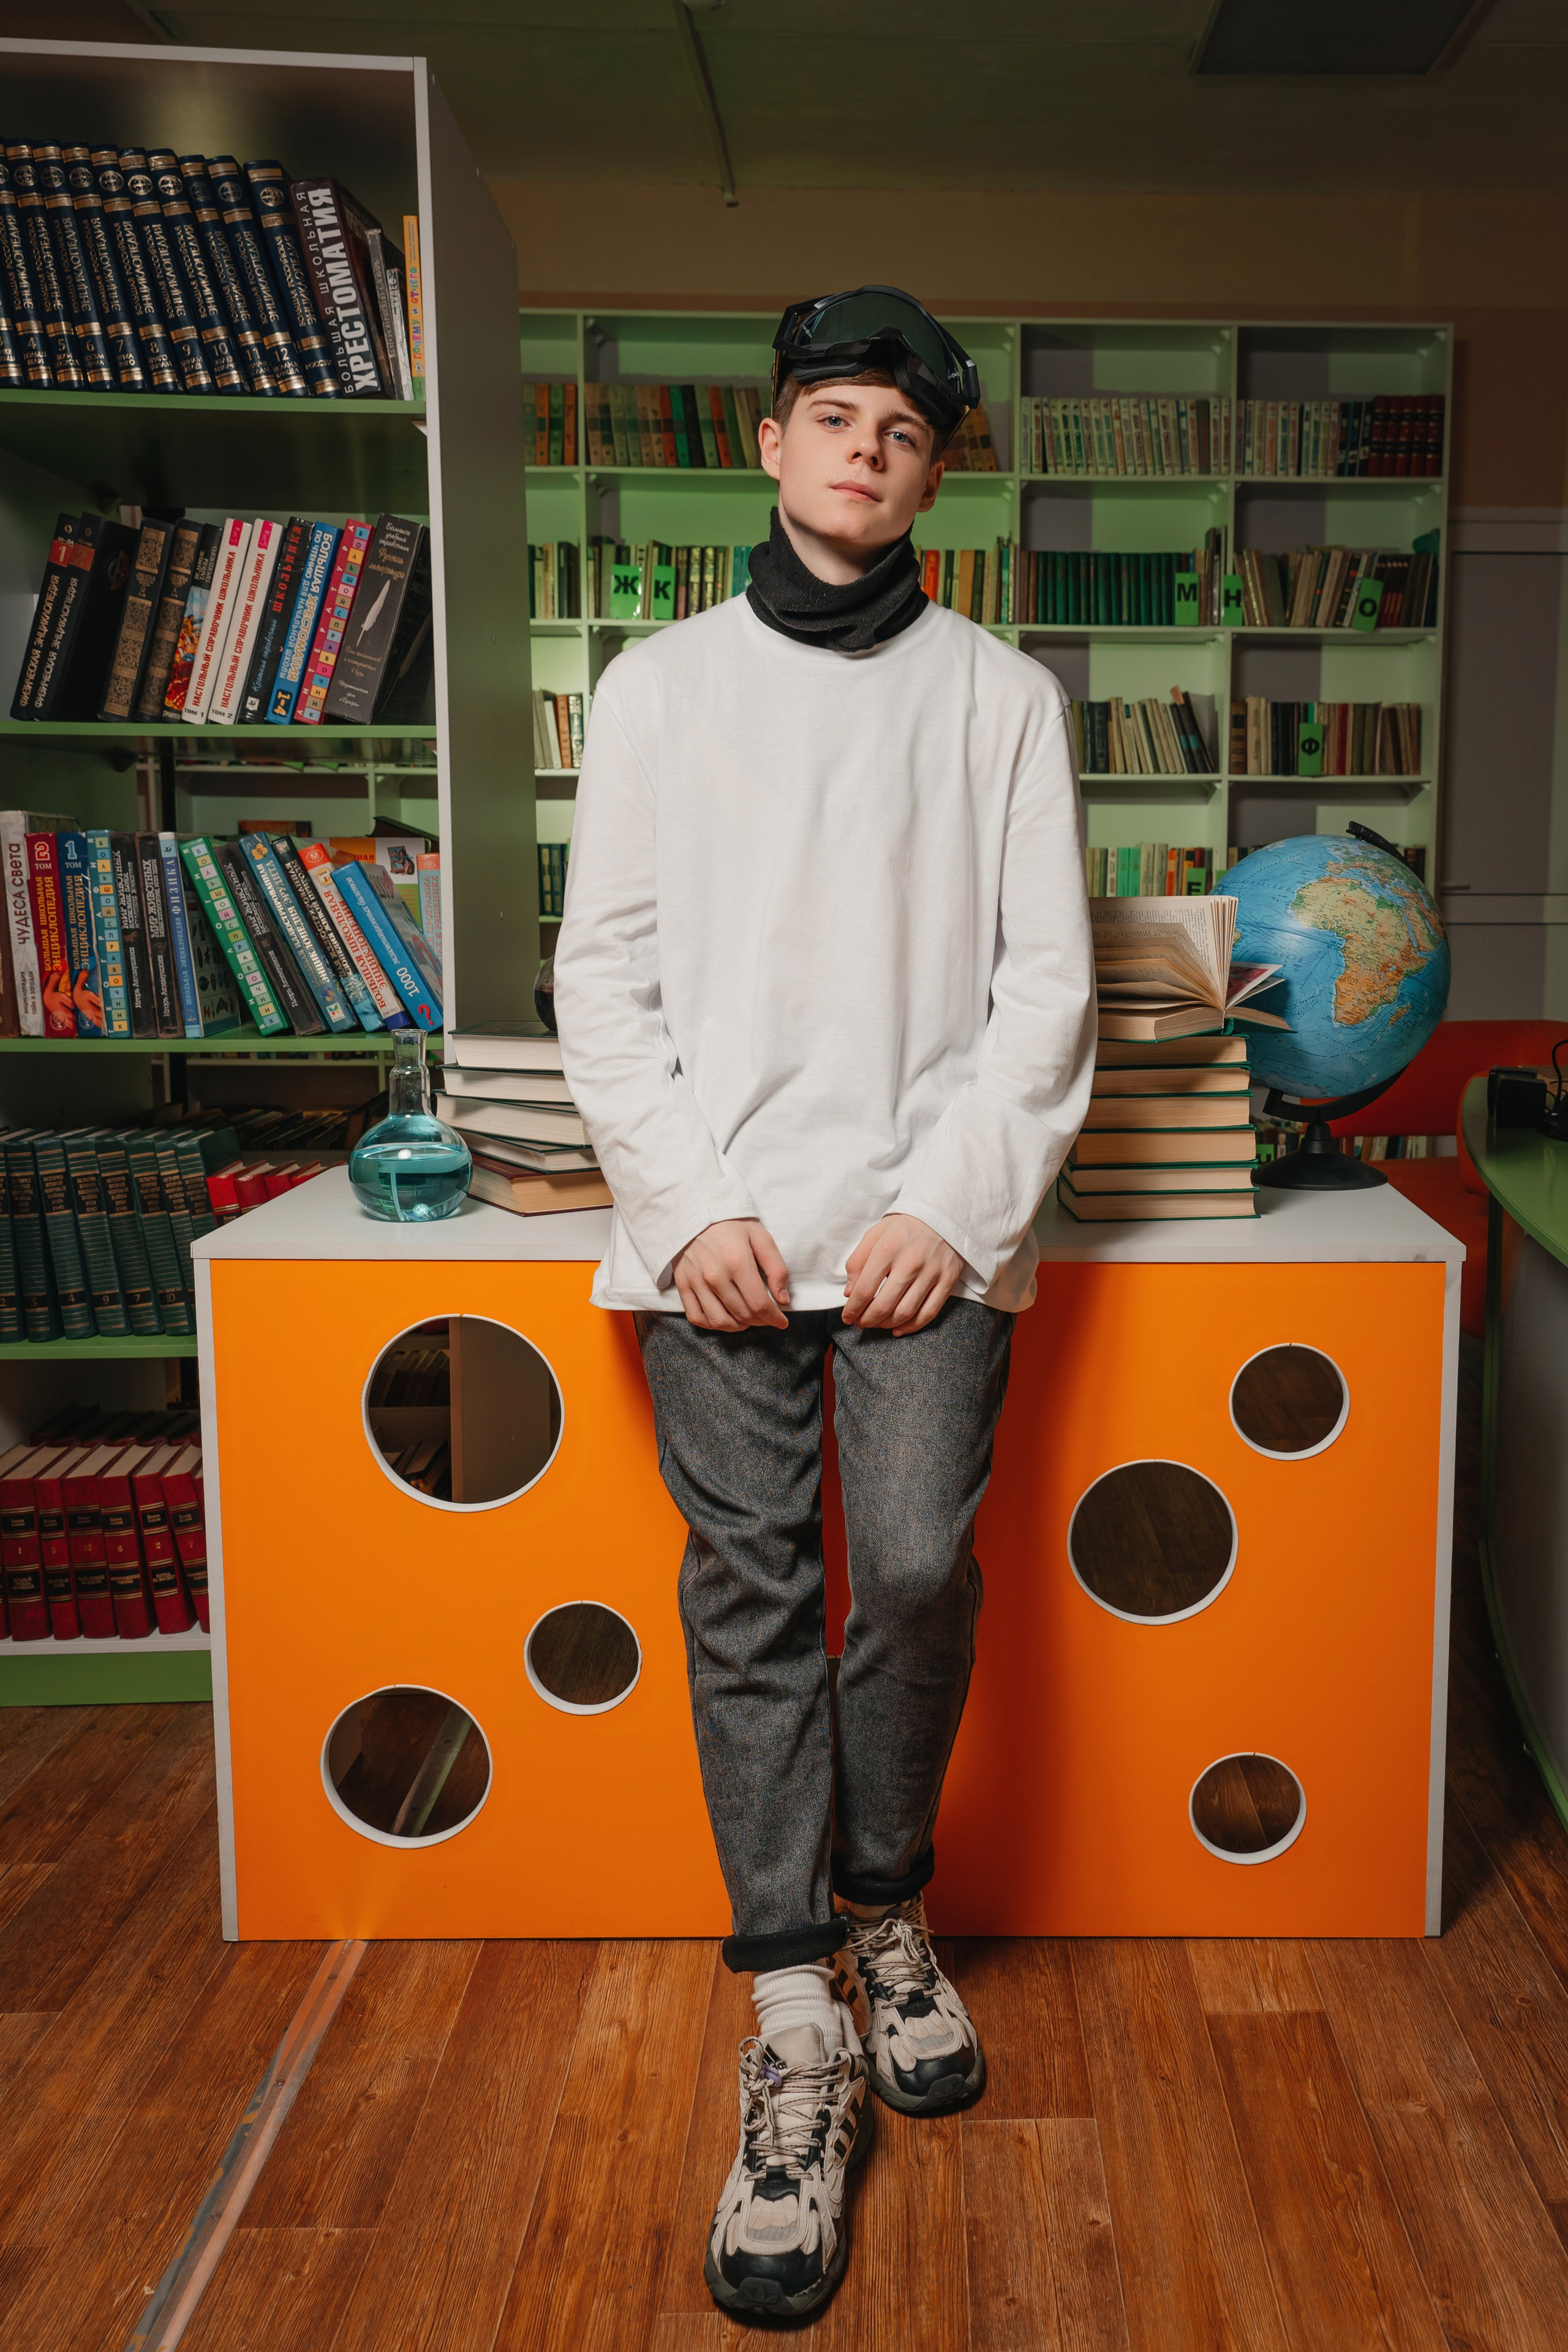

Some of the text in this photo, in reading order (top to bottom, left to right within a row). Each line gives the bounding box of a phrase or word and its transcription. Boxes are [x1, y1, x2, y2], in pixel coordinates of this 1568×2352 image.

[7, 215, 34, 309] ЭНЦИКЛОПЕДИЯ
[9, 272, 21, 310] БОЛЬШАЯ
[26, 217, 51, 312] БОЛЬШАЯ РОССИЙСКАЯ
[36, 216, 63, 311] ЭНЦИКЛОПЕДИЯ
[54, 219, 80, 313] БОЛЬШАЯ РОССИЙСКАЯ
[62, 217, 91, 311] ЭНЦИКЛОПЕДИЯ
[83, 219, 110, 314] БОЛЬШАЯ РОССИЙСКАЯ
[91, 217, 121, 312] ЭНЦИКЛОПЕДИЯ
[113, 222, 143, 316] БОЛЬШАЯ РОССИЙСКАЯ
[123, 221, 154, 314] ЭНЦИКЛОПЕДИЯ
[143, 225, 175, 319] БОЛЬШАЯ РОССИЙСКАЯ
[152, 224, 186, 317] ЭНЦИКЛОПЕДИЯ
[175, 225, 207, 318] БОЛЬШАЯ РОССИЙСКАЯ
[183, 224, 218, 317] ЭНЦИКЛОПЕДИЯ
[206, 232, 239, 323] БОЛЬШАЯ РОССИЙСКАЯ
[215, 230, 251, 321] ЭНЦИКЛОПЕДИЯ
[235, 233, 268, 324] БОЛЬШАЯ РОССИЙСКАЯ
[243, 231, 279, 322] ЭНЦИКЛОПЕДИЯ
[275, 236, 306, 326] БОЛЬШАЯ РОССИЙСКАЯ
[284, 235, 317, 325] ЭНЦИКЛОПЕДИЯ
[296, 192, 355, 394] БОЛЬШАЯ ШКОЛЬНАЯ
[307, 188, 379, 391] ХРЕСТОМАТИЯ
[28, 337, 37, 349] 4
[58, 339, 66, 352] 5
[86, 339, 94, 352] 6
[117, 339, 124, 352] 7
[150, 342, 159, 353] 8
[183, 344, 190, 356] 9
[213, 342, 228, 356] 10
[246, 348, 260, 361] 11
[274, 347, 290, 363] 12
[59, 546, 67, 562] 1
[379, 538, 410, 552] справочник
[379, 548, 404, 565] Русская
[386, 522, 410, 535] Большой
[279, 530, 323, 679] ПО ЧТЕНИЮ ДЛЯ НАЧАЛЬНОЙ ШКОЛЫ
[286, 532, 333, 682] БОЛЬШАЯ ХРЕСТОМАТИЯ
[613, 573, 639, 595] Ж
[654, 580, 671, 600] К
[1177, 584, 1197, 601] М
[1225, 589, 1242, 608] Н
[1359, 598, 1378, 616] О
[20, 575, 59, 706] ФИЗИЧЕСКАЯ ЭНЦИКЛОПЕДИЯ
[35, 578, 78, 707] ФИЗИЧЕСКАЯ ЭНЦИКЛОПЕДИЯ
[192, 551, 236, 706] НАСТОЛЬНЫЙ СПРАВОЧНИК ШКОЛЬНИКА
[221, 553, 265, 708] НАСТОЛЬНЫЙ СПРАВОЧНИК ШКОЛЬНИКА
[273, 691, 291, 716] 1-4
[1300, 737, 1320, 756] Ф
[35, 841, 50, 861] 2
[66, 840, 77, 859] 1
[112, 850, 129, 929] МИР ЖИВОТНЫХ
[165, 860, 181, 915] ФИЗИКА
[1187, 881, 1202, 895] Е
[13, 891, 31, 945] ЧУДЕСА
[36, 876, 51, 971] БОЛЬШАЯ ШКОЛЬНАЯ
[45, 876, 61, 971] ЭНЦИКЛОПЕДИЯ
[66, 875, 80, 970] БОЛЬШАЯ ШКОЛЬНАЯ
[74, 874, 91, 970] ЭНЦИКЛОПЕДИЯ
[142, 859, 159, 938] МИР ЖИВОТНЫХ
[256, 862, 301, 949] ИЛЛЮСТРИРОВАННАЯ
[265, 859, 331, 984] ЭНЦИКЛОПЕДИЯ ЭРУДИТА
[282, 858, 337, 956] ИЛЛЮСТРИРОВАННАЯ
[288, 856, 331, 930] ЖИВОЙ ПРИРОДЫ
[423, 876, 433, 934] ПРОГРАММА
[431, 875, 441, 929] РЕШЕНИЯХ
[129, 946, 142, 1008] Игорь Акимушкин
[175, 917, 192, 1006] ШКОЛЬНАЯ ЭНЦИКЛОПЕДИЯ
[323, 889, 386, 1008] БОЛЬШАЯ ШКОЛЬНАЯ
[338, 899, 388, 989] ЭНЦИКЛОПЕДИЯ
[344, 875, 420, 998] 1000 экзаменационных билетов
[157, 954, 171, 1017] Игорь Акимушкин
[286, 989, 298, 1008] Игорь
[67, 1294, 75, 1303] 4
[102, 1295, 109, 1304] 9
[134, 1294, 141, 1303] 7
[166, 1294, 176, 1303] 10
